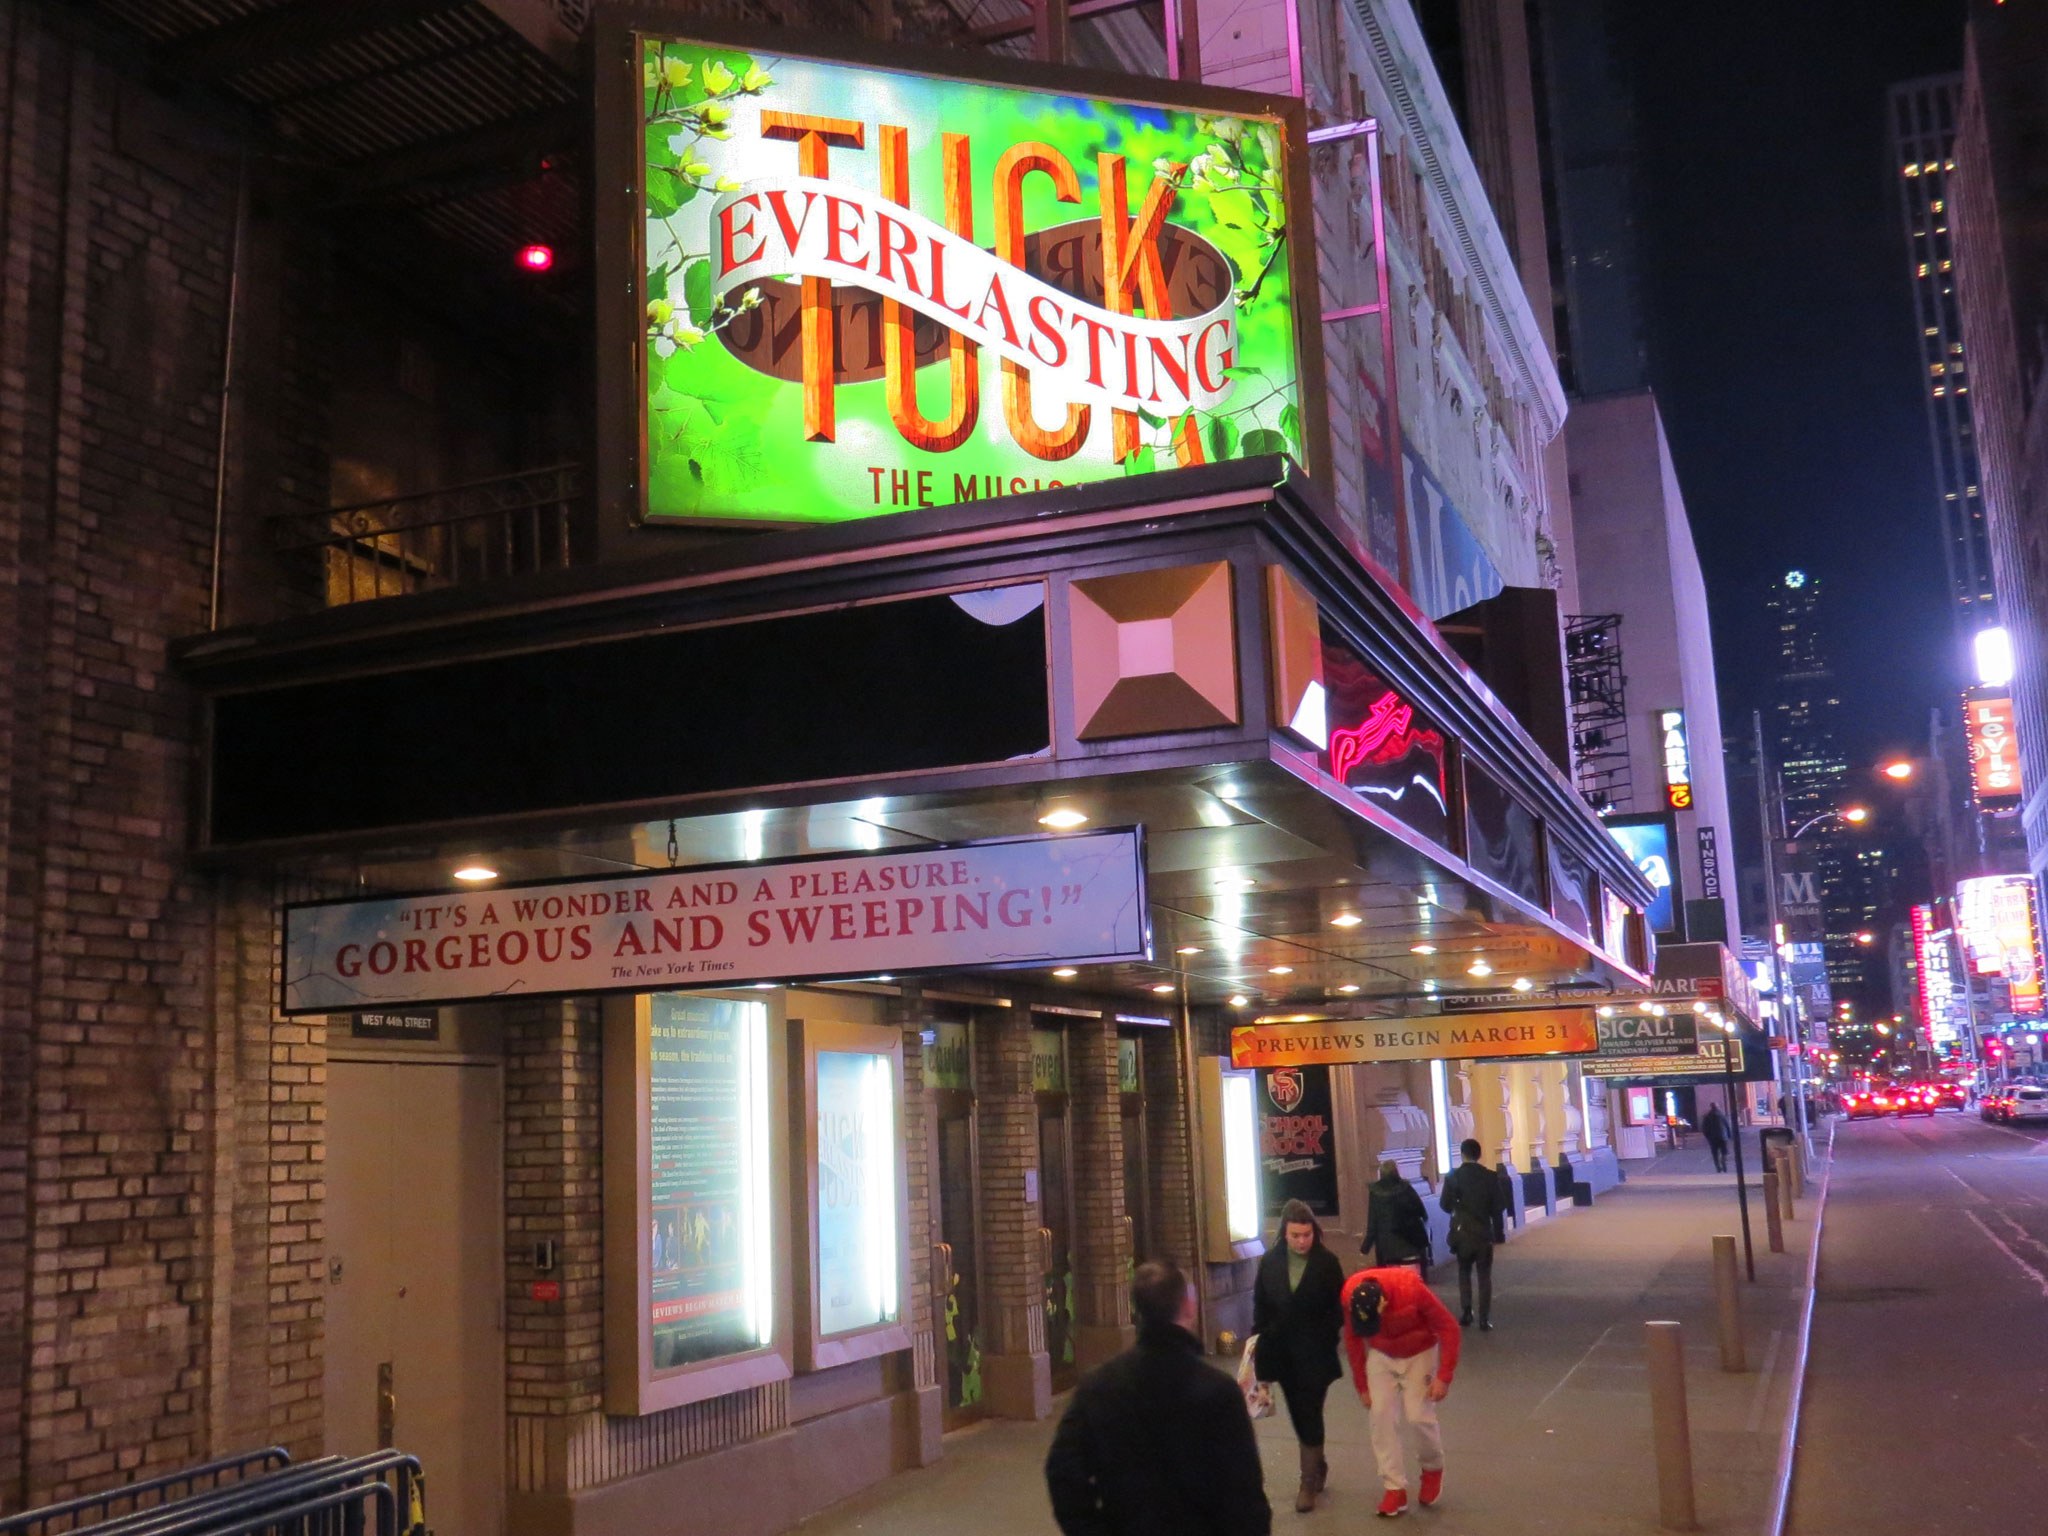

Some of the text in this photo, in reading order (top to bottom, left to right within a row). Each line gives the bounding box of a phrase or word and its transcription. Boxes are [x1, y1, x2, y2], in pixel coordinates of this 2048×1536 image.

[716, 189, 1231, 402] EVERLASTING
[760, 108, 1205, 467] TUCK
[868, 467, 934, 508] THE
[1661, 712, 1690, 785] PARK
[1700, 831, 1719, 900] MINSKOF
[480, 903, 500, 926] A
[512, 888, 654, 922] WONDER
[666, 880, 738, 909] AND
[752, 878, 776, 902] A
[789, 860, 982, 899] PLEASURE.
[1780, 872, 1821, 904] M
[336, 924, 592, 978] GORGEOUS
[613, 914, 724, 958] AND
[611, 959, 735, 978] The New York Times
[361, 1014, 384, 1026] WEST
[386, 1015, 403, 1027] 44th
[405, 1016, 432, 1029] STREET
[1600, 1017, 1676, 1040] SICAL!
[1256, 1024, 1569, 1053] PREVIEWS BEGIN MARCH 31
[1608, 1046, 1649, 1055] STANDARD
[1650, 1045, 1679, 1053] AWARD
[1665, 1037, 1695, 1045] AWARD
[1260, 1113, 1328, 1133] SCHOOL
[1261, 1132, 1325, 1155] ROCK
